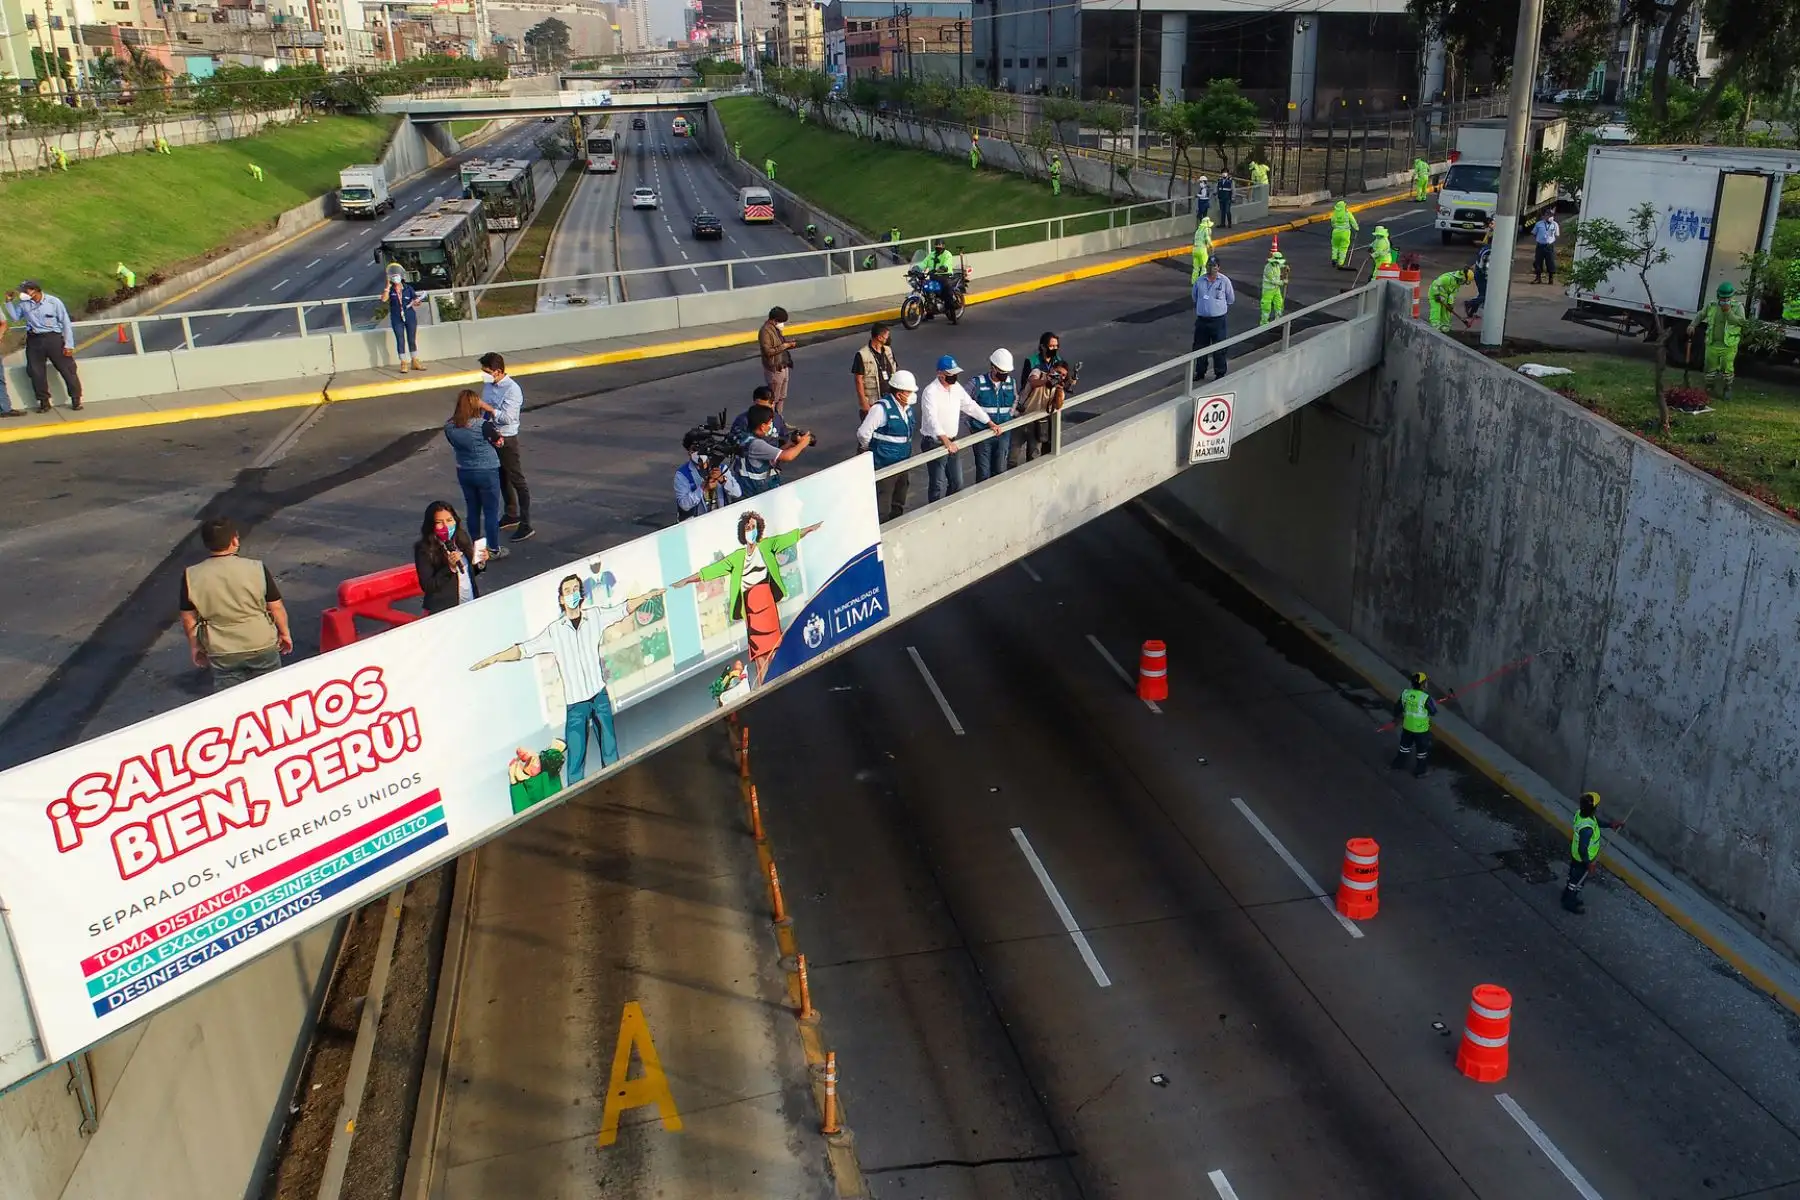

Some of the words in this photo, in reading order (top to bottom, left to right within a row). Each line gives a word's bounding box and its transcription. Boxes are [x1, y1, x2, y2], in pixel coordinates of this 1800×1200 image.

[1195, 446, 1225, 458] MAXIMA
[1196, 438, 1226, 447] ALTURA
[1203, 409, 1225, 424] 4.00
[834, 590, 873, 613] MUNICIPALIDAD
[872, 586, 880, 594] DE
[835, 597, 883, 633] LIMA
[46, 666, 387, 853] ¡SALGAMOS
[111, 776, 270, 880] BIEN,
[275, 707, 421, 807] PERÚ!
[88, 868, 220, 936] SEPARADOS,
[225, 804, 352, 869] VENCEREMOS
[357, 772, 422, 809] UNIDOS
[102, 953, 155, 989] PAGA
[158, 917, 229, 959] EXACTO
[232, 908, 247, 921] O
[251, 857, 350, 912] DESINFECTA
[352, 848, 371, 862] EL
[372, 816, 428, 850] VUELTO
[94, 932, 153, 967] TOMA
[155, 883, 251, 937] DISTANCIA
[108, 944, 223, 1009] DESINFECTA
[224, 922, 258, 948] TUS
[262, 890, 323, 928] MANOS
[597, 1000, 684, 1148] A
